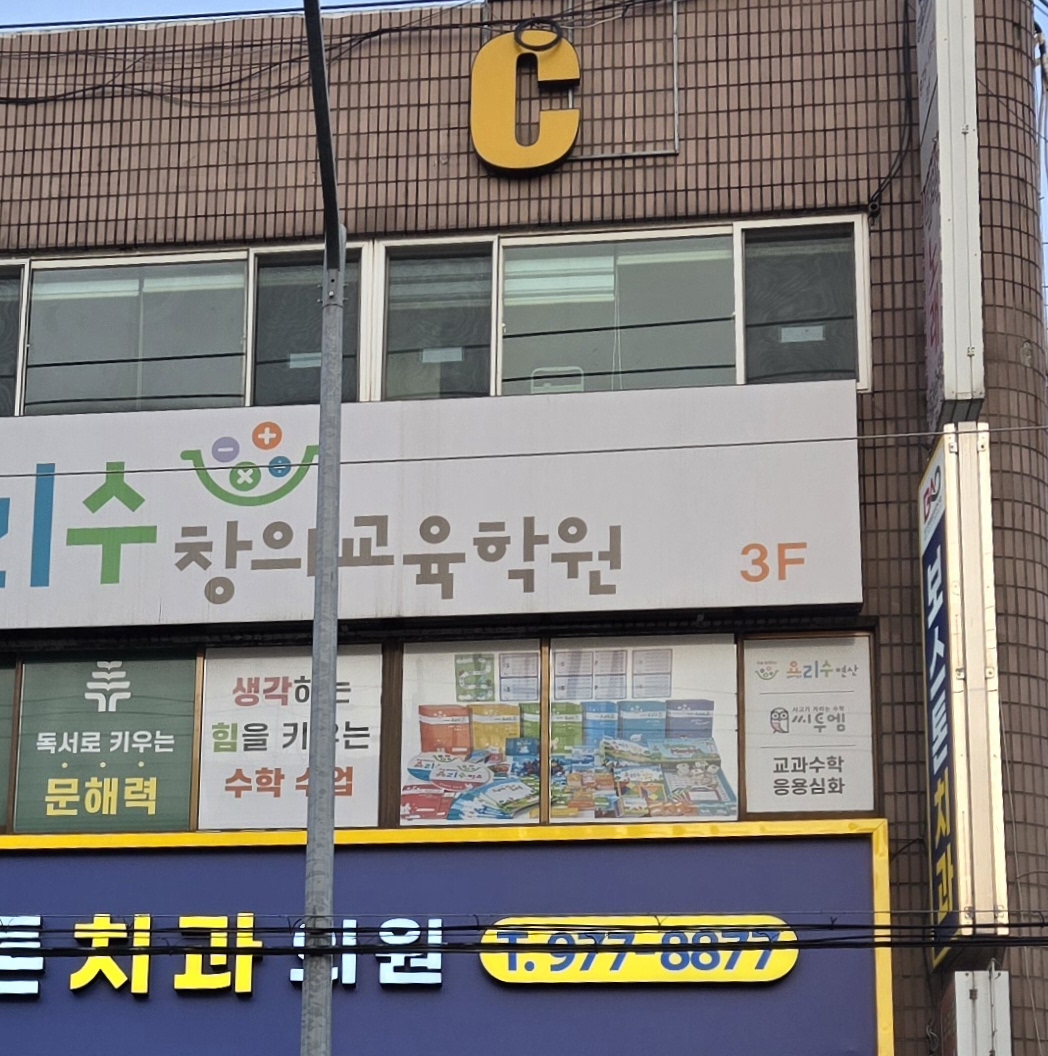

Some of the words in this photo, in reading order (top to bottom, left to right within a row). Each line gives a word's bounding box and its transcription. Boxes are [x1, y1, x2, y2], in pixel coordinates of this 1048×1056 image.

[740, 542, 807, 582] 3F
[786, 660, 833, 678] 요리수
[835, 664, 859, 678] 연산
[36, 731, 101, 754] 독서로
[109, 730, 175, 754] 키우는
[212, 722, 269, 753] 힘을
[282, 721, 370, 750] 키는
[773, 755, 844, 774] 교과수학
[224, 767, 285, 798] 수학
[773, 777, 845, 796] 응용심화
[44, 777, 157, 816] 문해력
